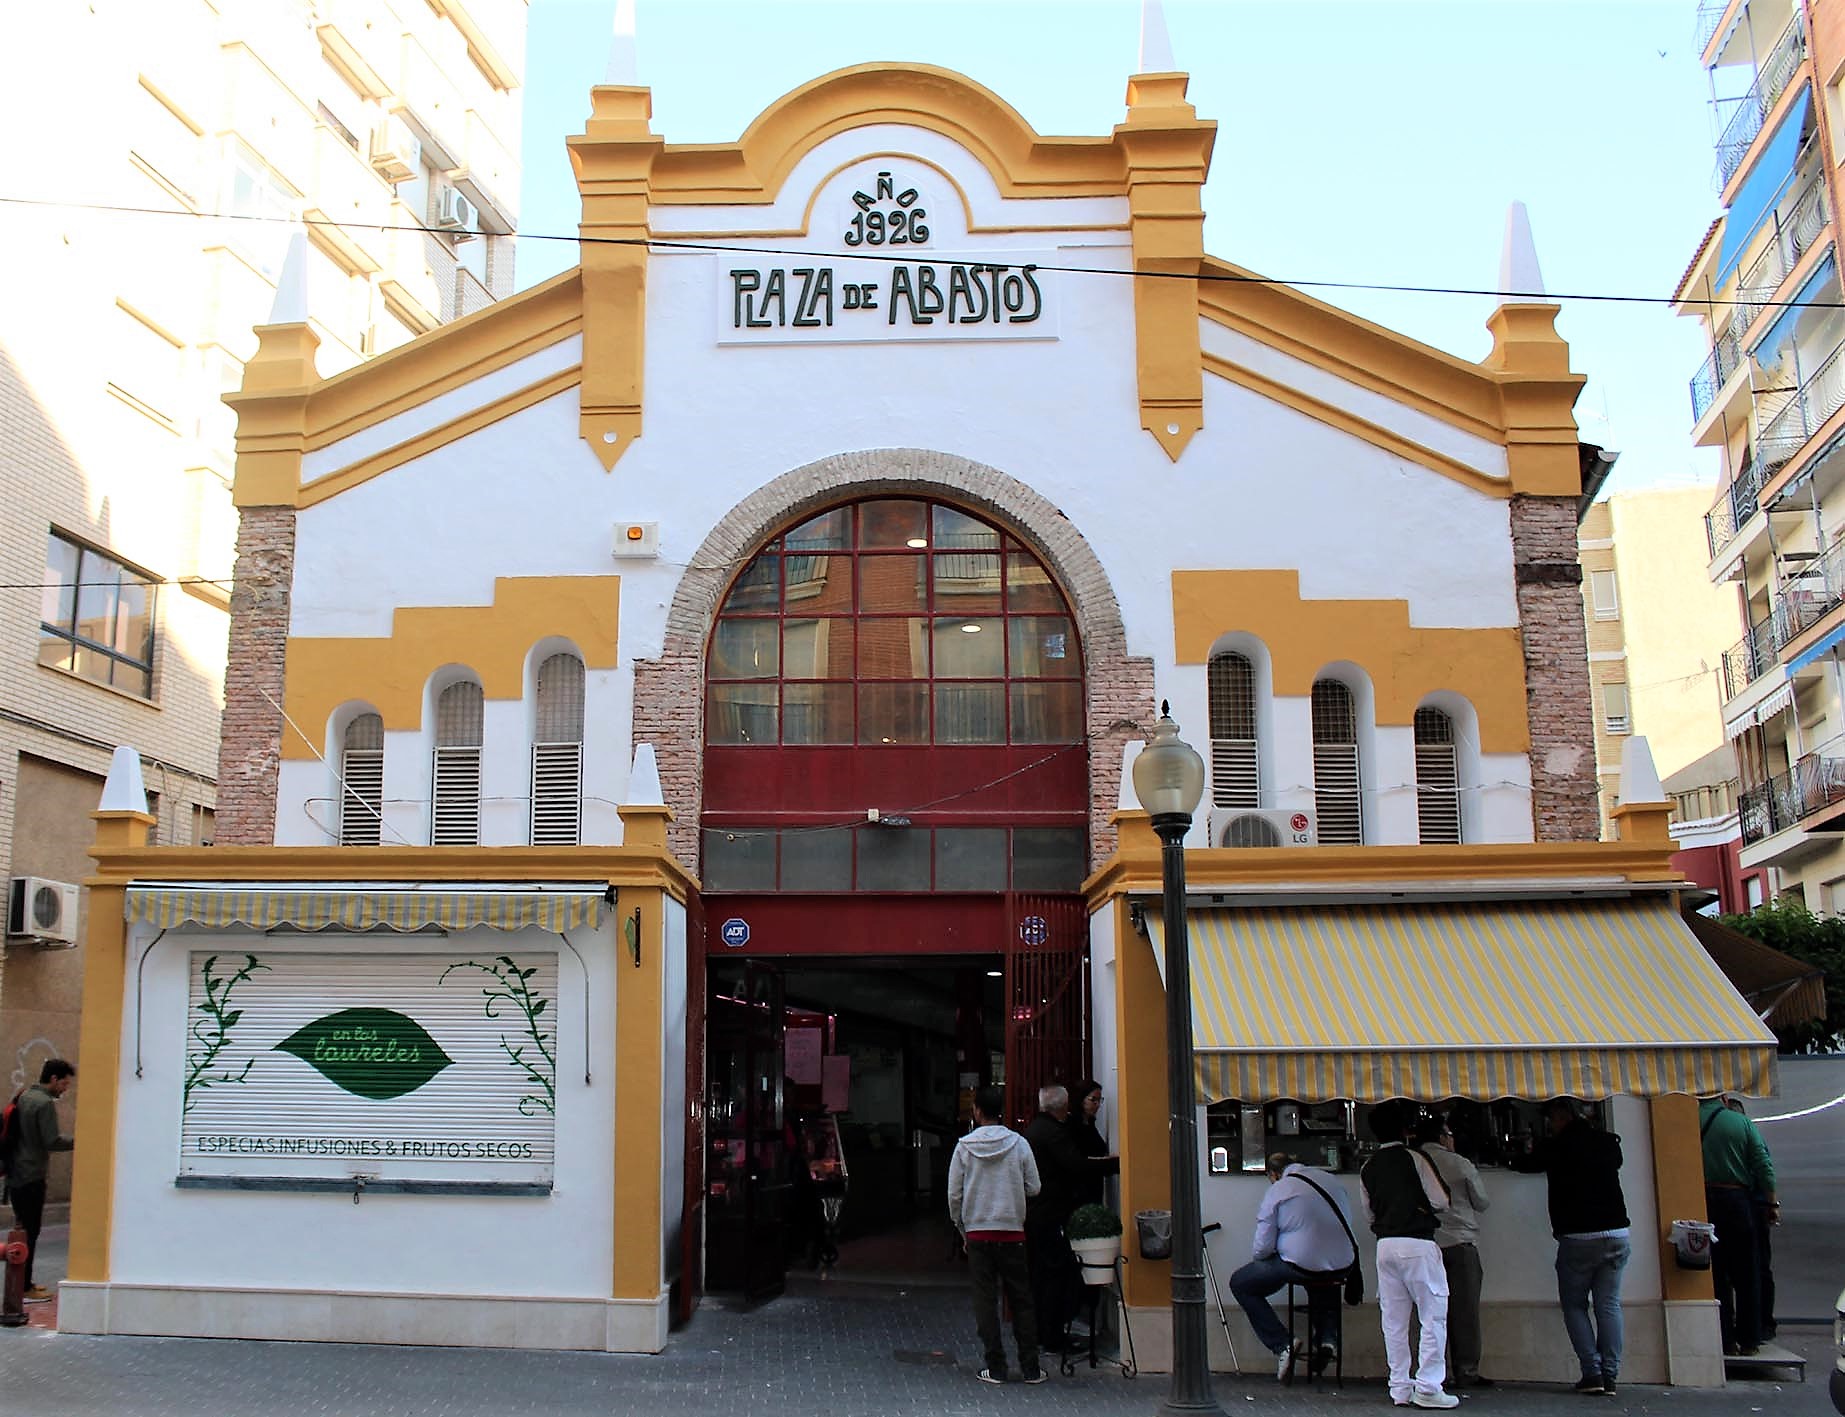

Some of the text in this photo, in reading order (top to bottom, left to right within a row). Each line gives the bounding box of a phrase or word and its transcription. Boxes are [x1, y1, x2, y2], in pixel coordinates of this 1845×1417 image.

[852, 171, 919, 212] AÑO
[844, 208, 930, 246] 1926
[730, 264, 1042, 328] PLAZA DE ABASTOS
[1293, 833, 1308, 844] LG
[727, 926, 745, 937] ADT
[314, 1038, 420, 1063] laureles
[279, 1138, 381, 1156] INFUSIONES
[385, 1140, 397, 1156] &
[402, 1141, 471, 1158] FRUTOS
